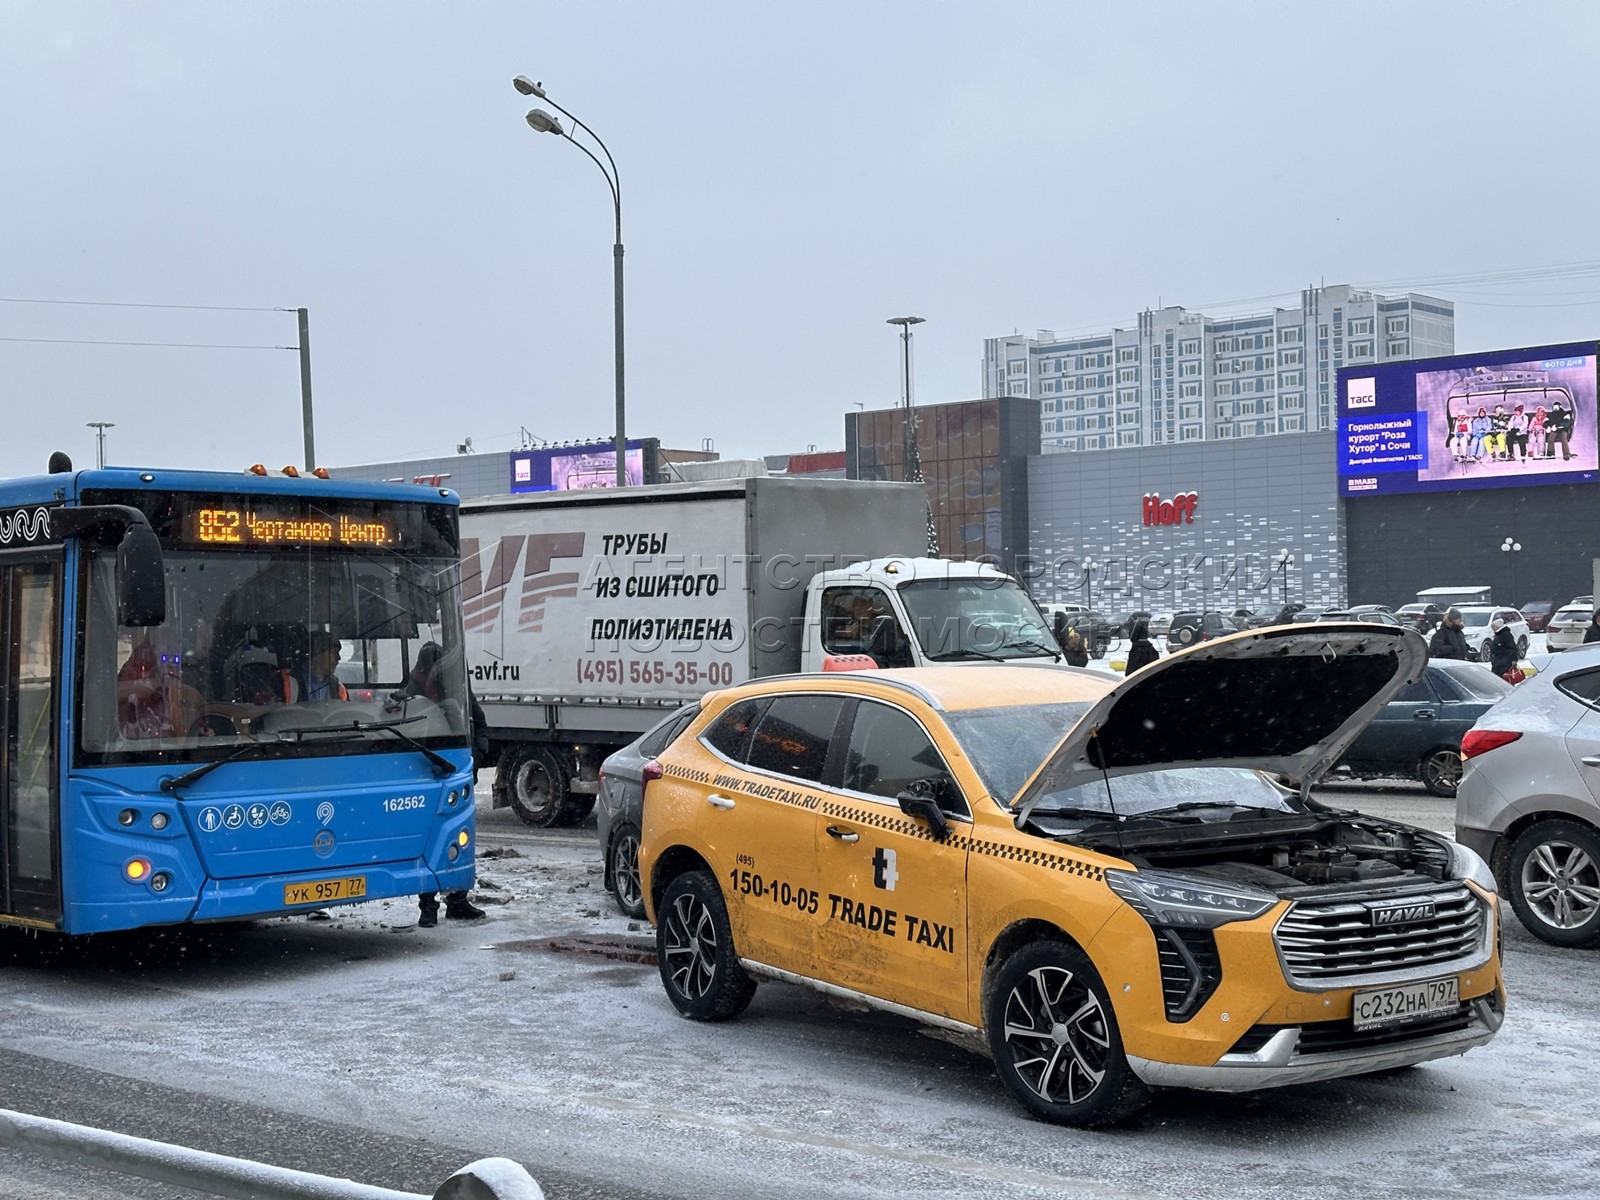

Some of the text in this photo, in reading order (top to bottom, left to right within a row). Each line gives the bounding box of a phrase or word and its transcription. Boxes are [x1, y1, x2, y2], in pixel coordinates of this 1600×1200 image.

[1544, 359, 1583, 368] ФОТО ДНЯ
[1348, 419, 1412, 432] Горнолыжный
[1348, 434, 1379, 443] курорт
[1387, 442, 1411, 450] Сочи
[246, 511, 332, 543] Чертаново
[602, 532, 668, 556] ТРУБЫ
[595, 574, 719, 599] ИЗ СШИТОГО
[590, 618, 734, 641] ПОЛИЭТИЛЕНА
[576, 658, 733, 686] (495) 565-35-00
[712, 774, 822, 810] WWW.TRADETAXI.RU
[382, 795, 426, 812] 162562
[736, 853, 755, 869] (495)
[315, 882, 341, 899] 957
[349, 879, 361, 891] 77
[730, 868, 819, 915] 150-10-05
[828, 893, 954, 953] TRADE TAXI
[1377, 906, 1433, 923] HAVAL
[1429, 981, 1454, 1001] 797
